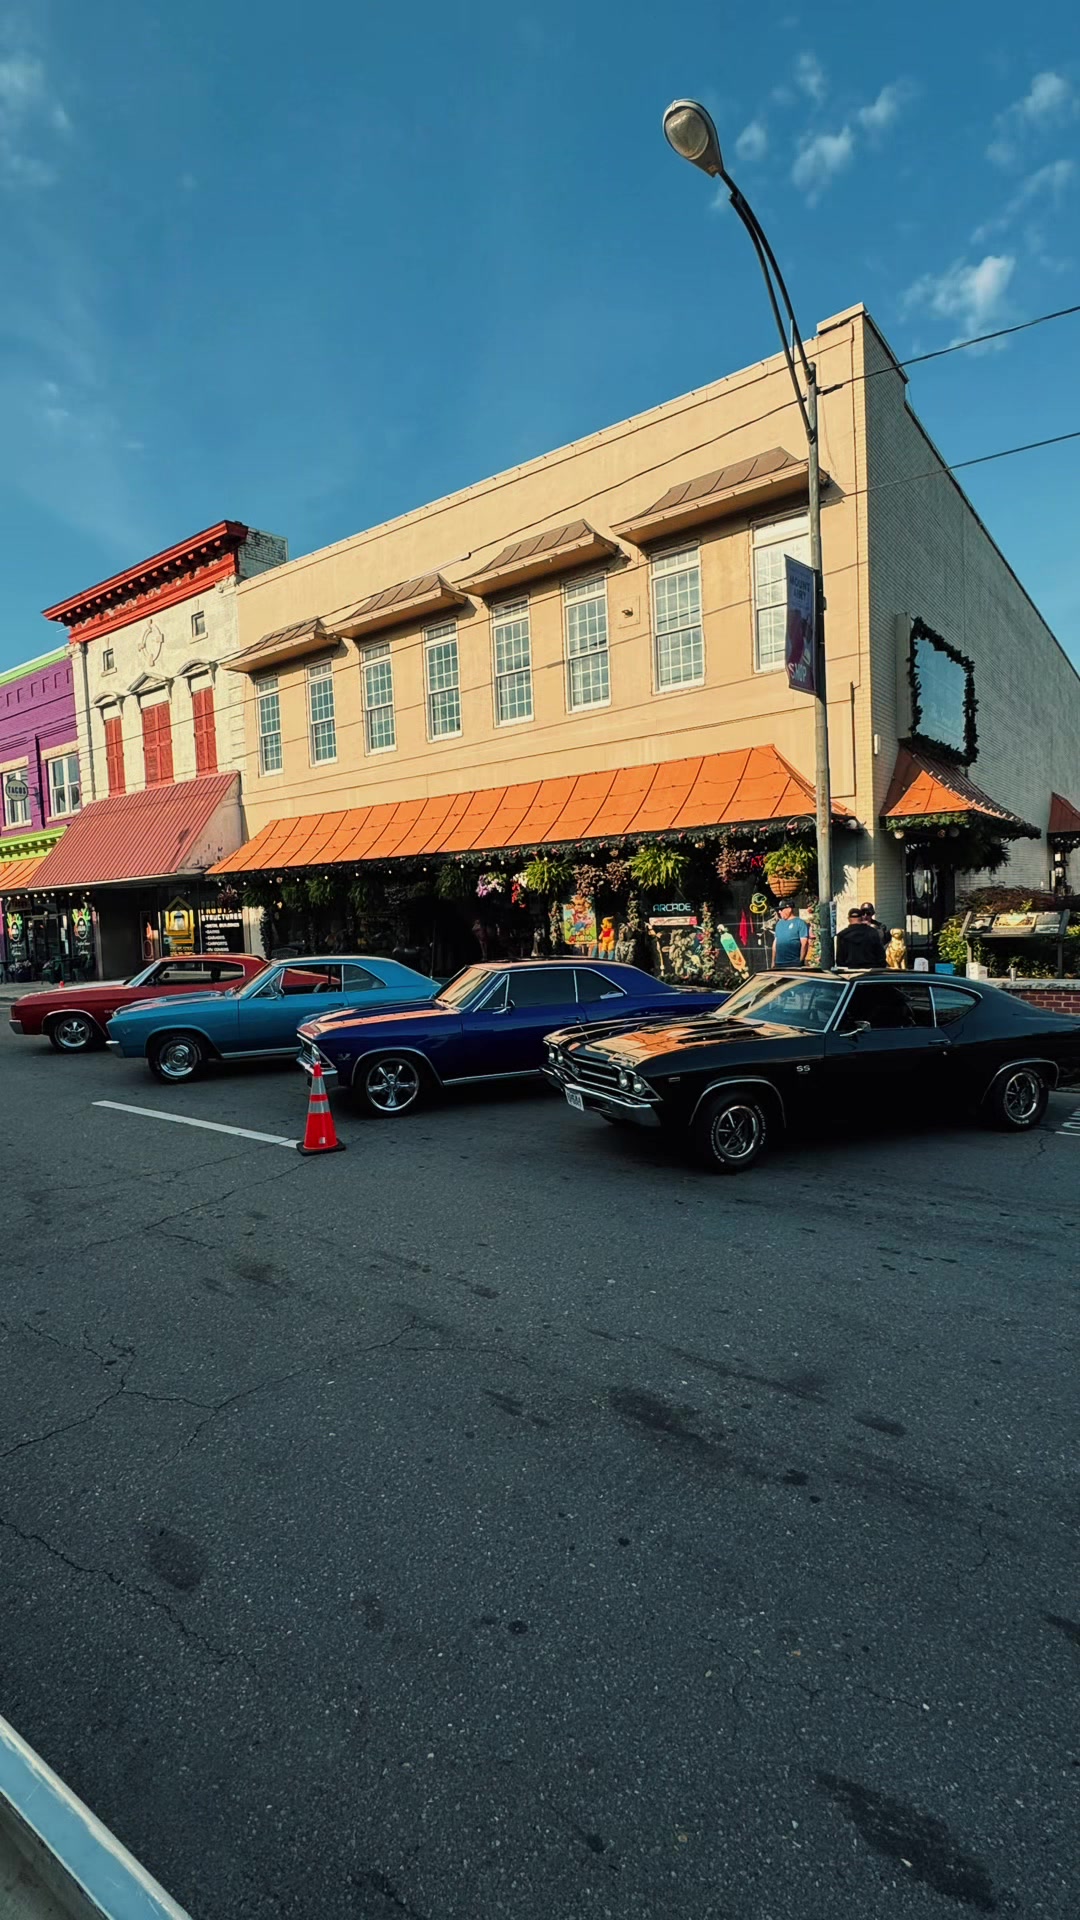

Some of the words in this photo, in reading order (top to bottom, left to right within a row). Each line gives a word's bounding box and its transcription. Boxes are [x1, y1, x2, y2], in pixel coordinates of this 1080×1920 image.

[8, 786, 27, 795] TACOS
[652, 903, 692, 912] ARCADE
[201, 913, 243, 921] STRUCTURES
[796, 1064, 811, 1072] SS
